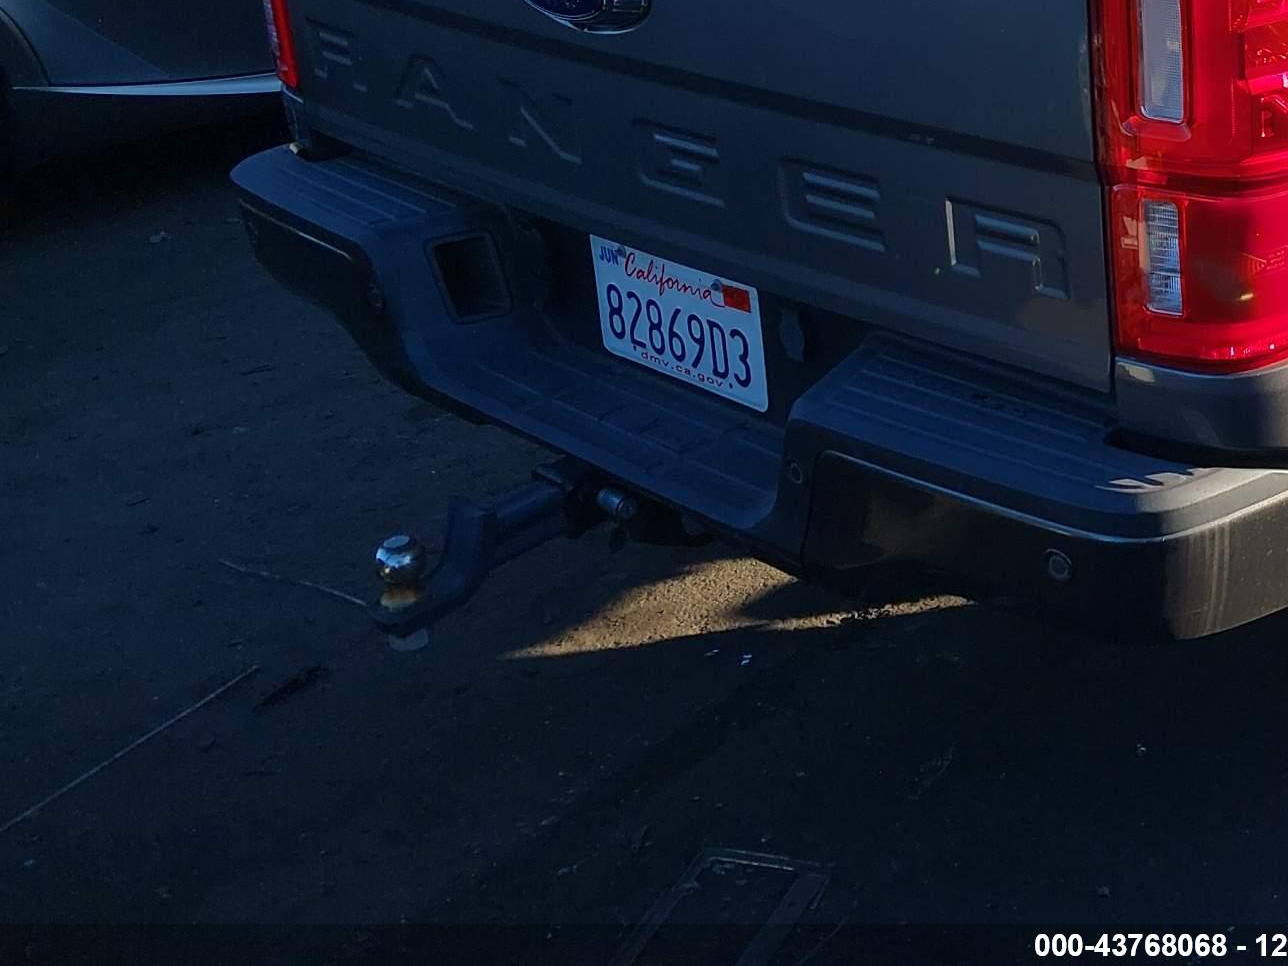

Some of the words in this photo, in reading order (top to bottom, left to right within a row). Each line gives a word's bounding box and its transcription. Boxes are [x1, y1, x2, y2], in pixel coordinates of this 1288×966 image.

[304, 16, 1072, 302] RANGER
[599, 245, 619, 267] JUN
[624, 251, 726, 308] California
[606, 283, 752, 388] 82869D3
[640, 351, 724, 388] dmv.ca.gov
